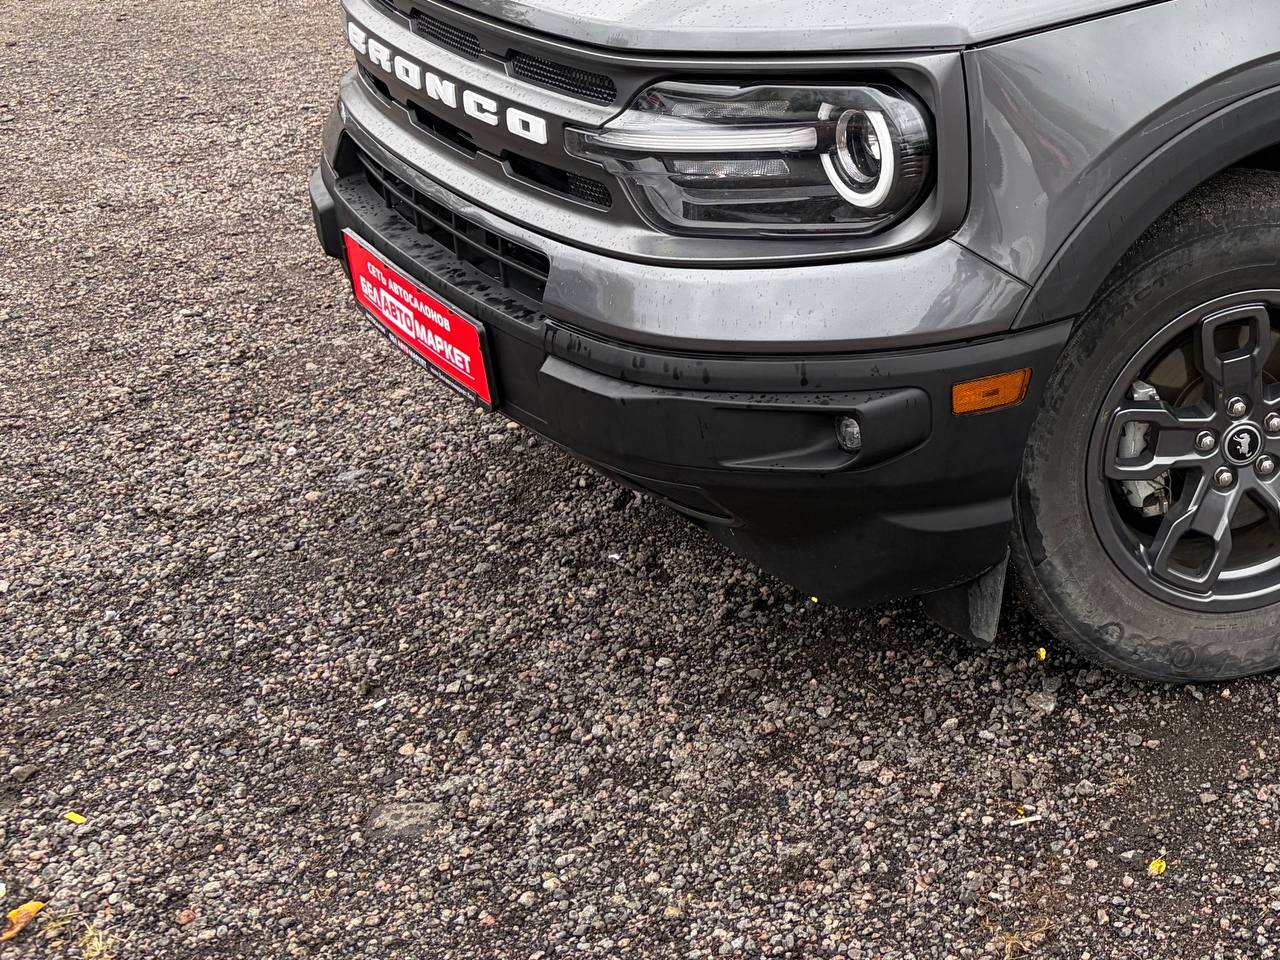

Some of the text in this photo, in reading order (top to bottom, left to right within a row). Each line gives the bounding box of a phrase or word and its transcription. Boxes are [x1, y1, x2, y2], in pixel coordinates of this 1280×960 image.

[347, 21, 548, 145] BRONCO
[367, 261, 387, 285] СЕТЬ
[388, 277, 451, 332] АВТОСАЛОНОВ
